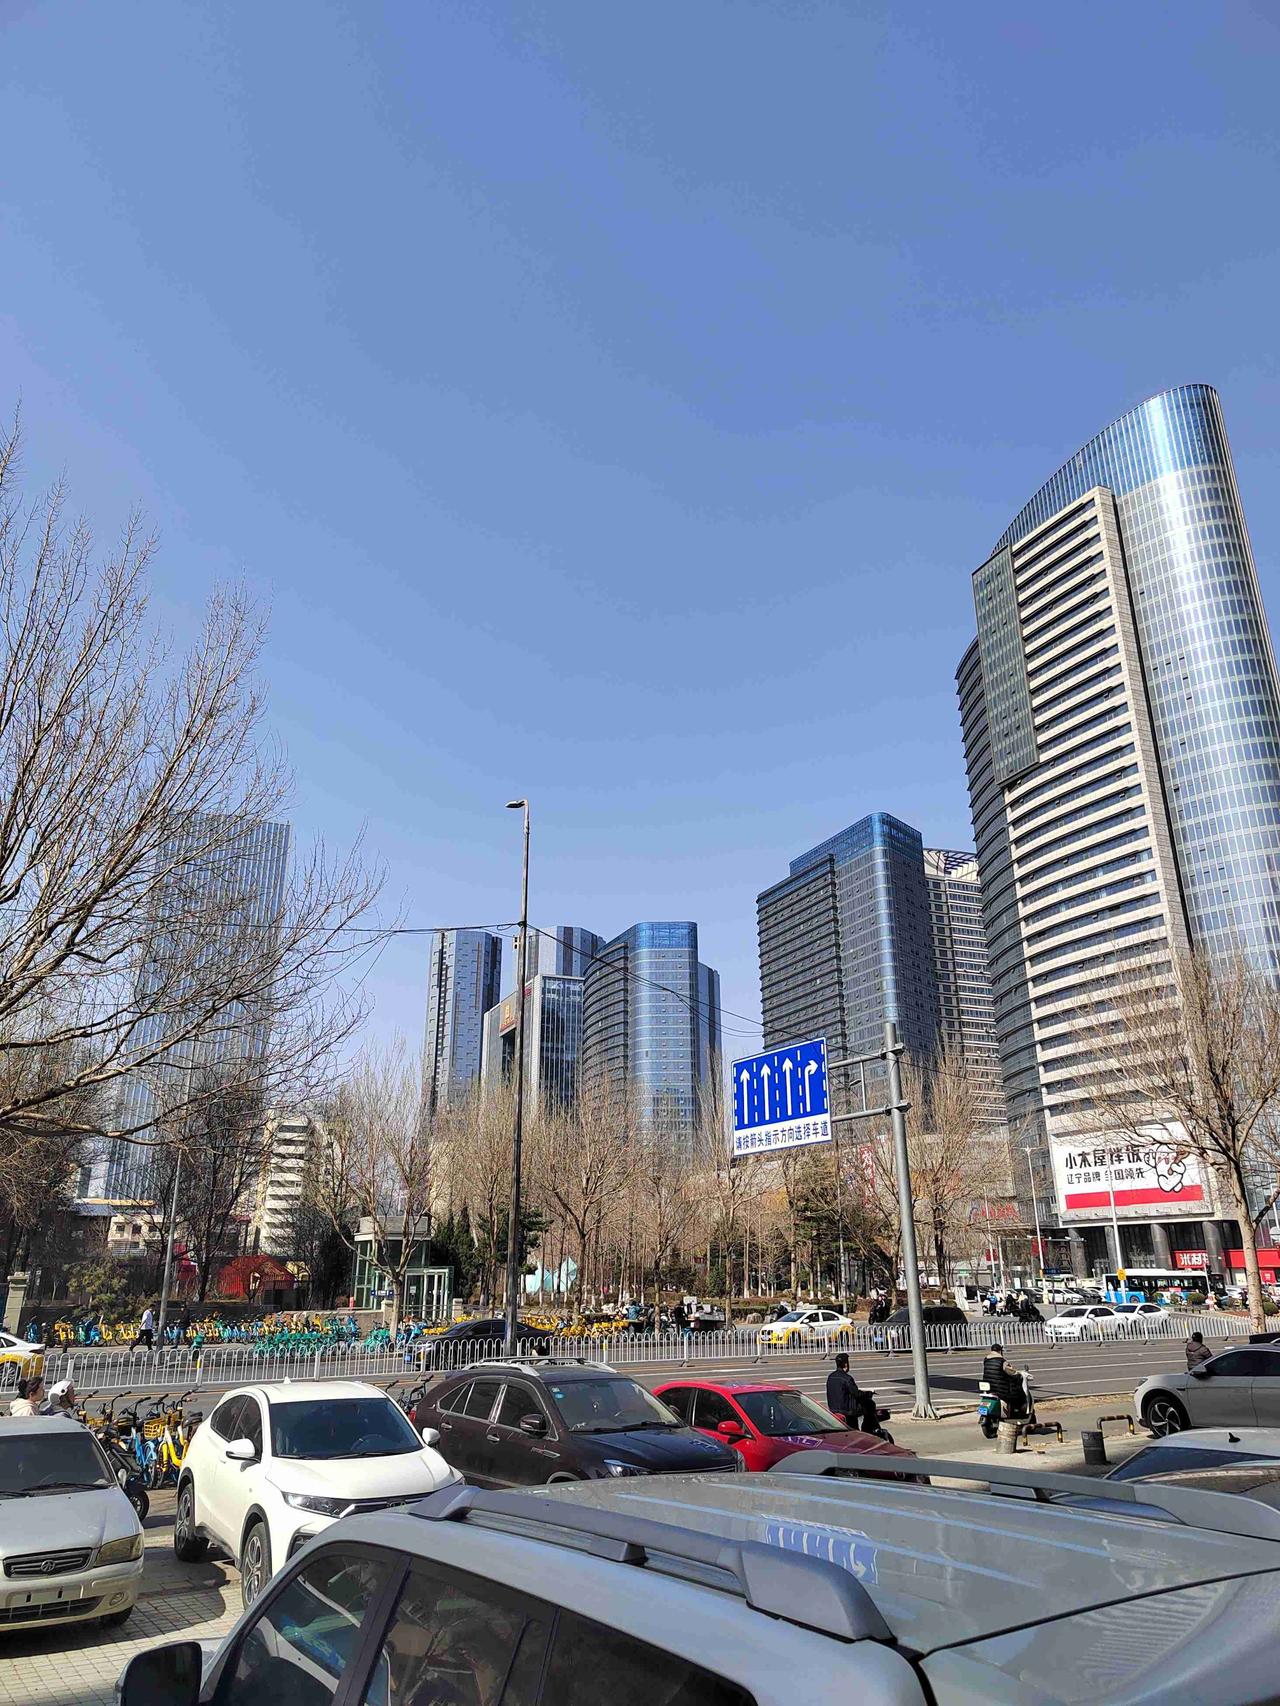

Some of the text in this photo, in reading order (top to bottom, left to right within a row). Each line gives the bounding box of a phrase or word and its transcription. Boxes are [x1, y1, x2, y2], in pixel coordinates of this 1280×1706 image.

[735, 1120, 829, 1151] 请按箭头指示方向选择车道
[1067, 1171, 1101, 1184] 辽宁品牌
